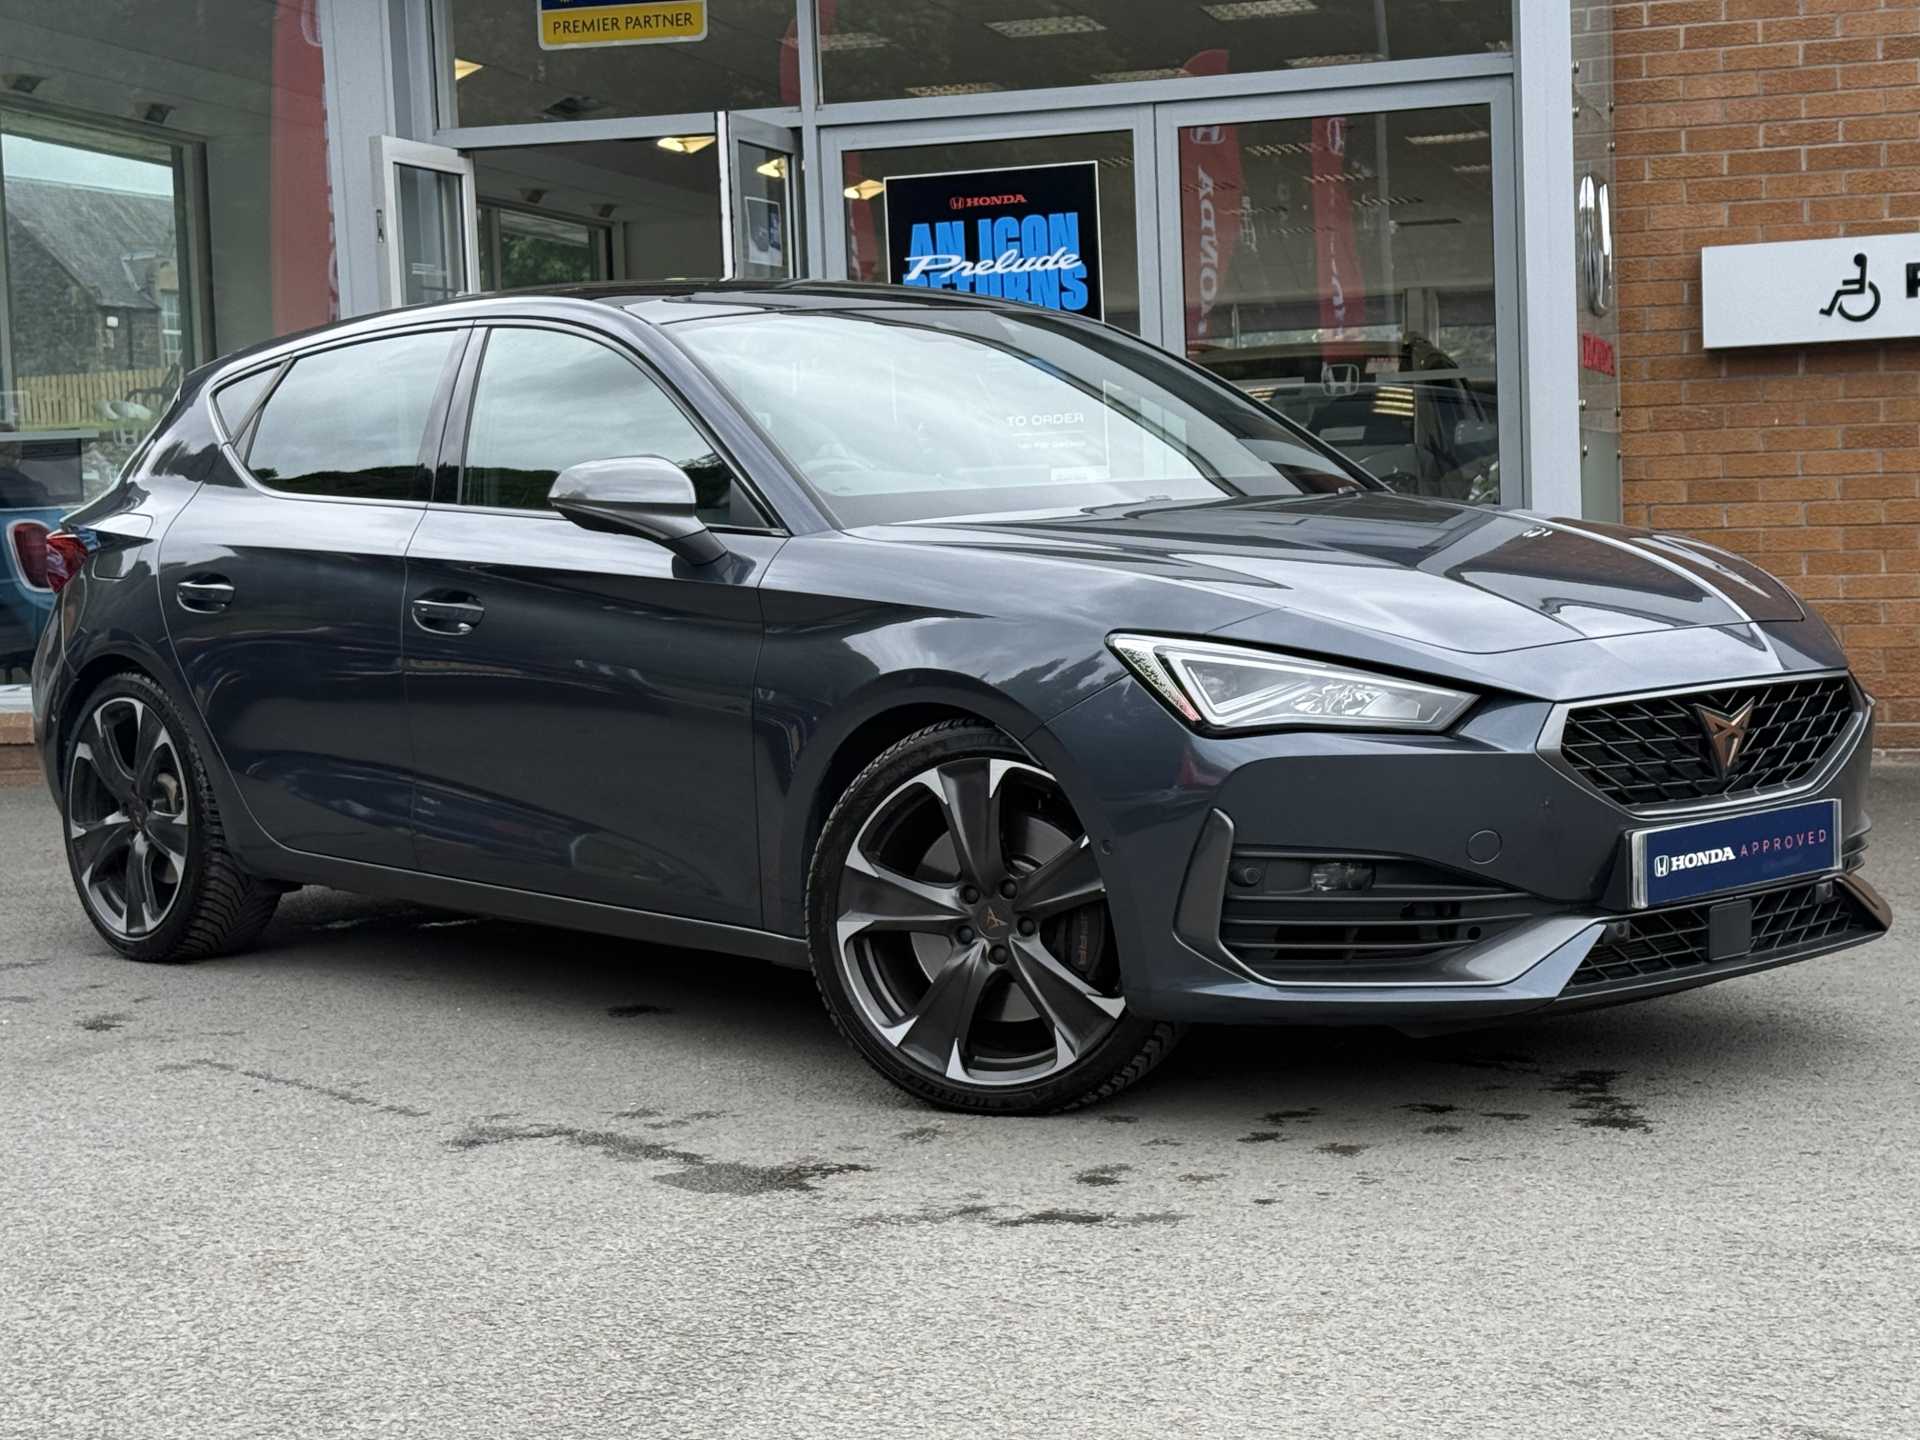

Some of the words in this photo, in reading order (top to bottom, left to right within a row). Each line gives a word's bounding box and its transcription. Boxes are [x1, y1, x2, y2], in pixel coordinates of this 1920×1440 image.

[553, 17, 621, 34] PREMIER
[625, 12, 694, 30] PARTNER
[966, 194, 1027, 208] HONDA
[909, 221, 966, 272] AN
[977, 212, 1080, 266] ICON
[904, 246, 1082, 281] Prelude
[903, 262, 1089, 311] URNS
[1671, 847, 1736, 871] HONDA
[1740, 828, 1827, 857] APPROVED
